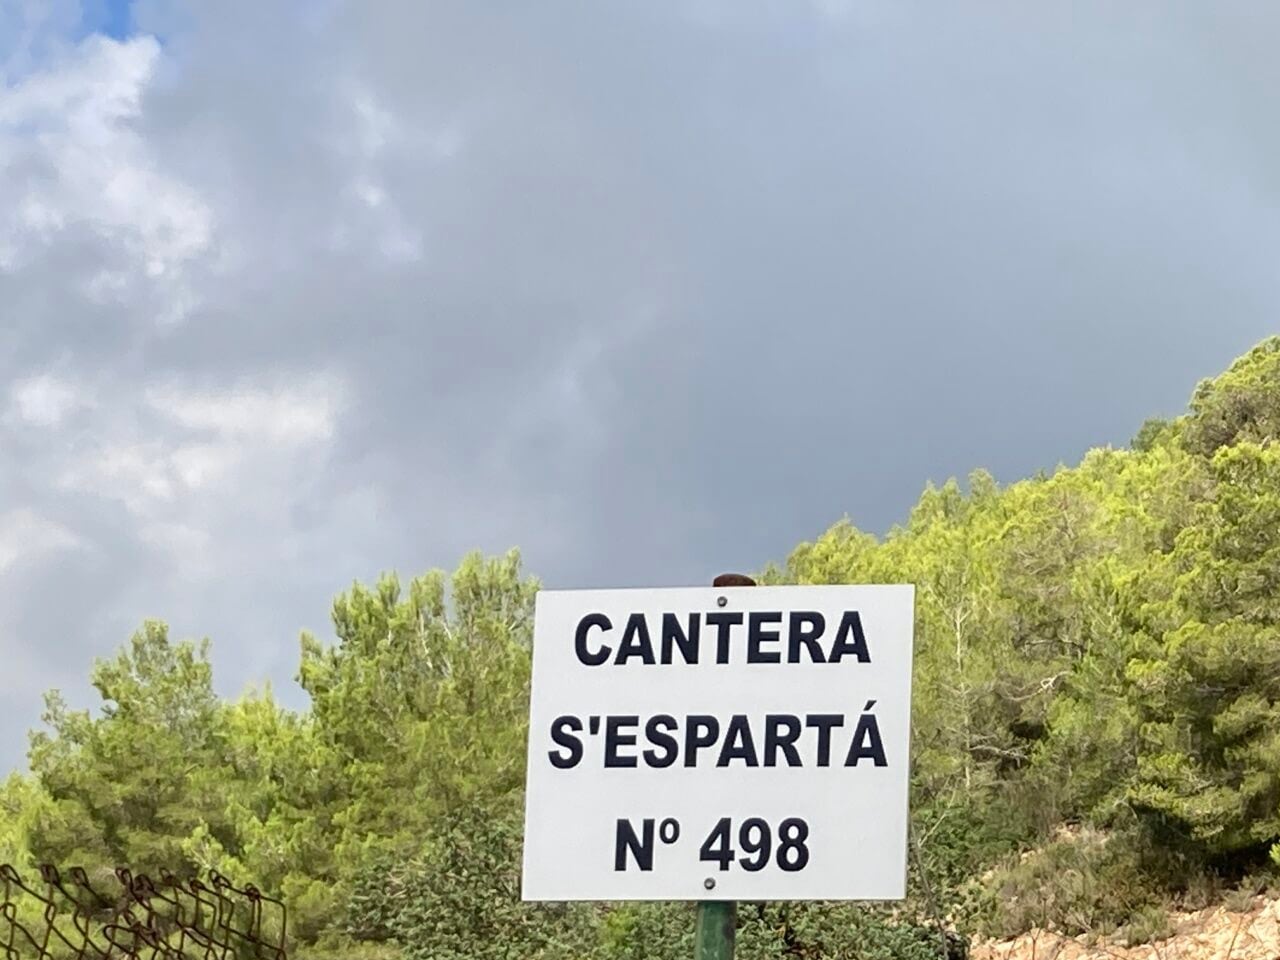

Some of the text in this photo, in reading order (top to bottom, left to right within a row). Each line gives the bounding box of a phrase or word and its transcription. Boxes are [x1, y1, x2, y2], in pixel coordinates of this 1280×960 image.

[574, 610, 872, 667] CANTERA
[548, 699, 889, 770] S'ESPARTÁ
[699, 816, 810, 873] 498
